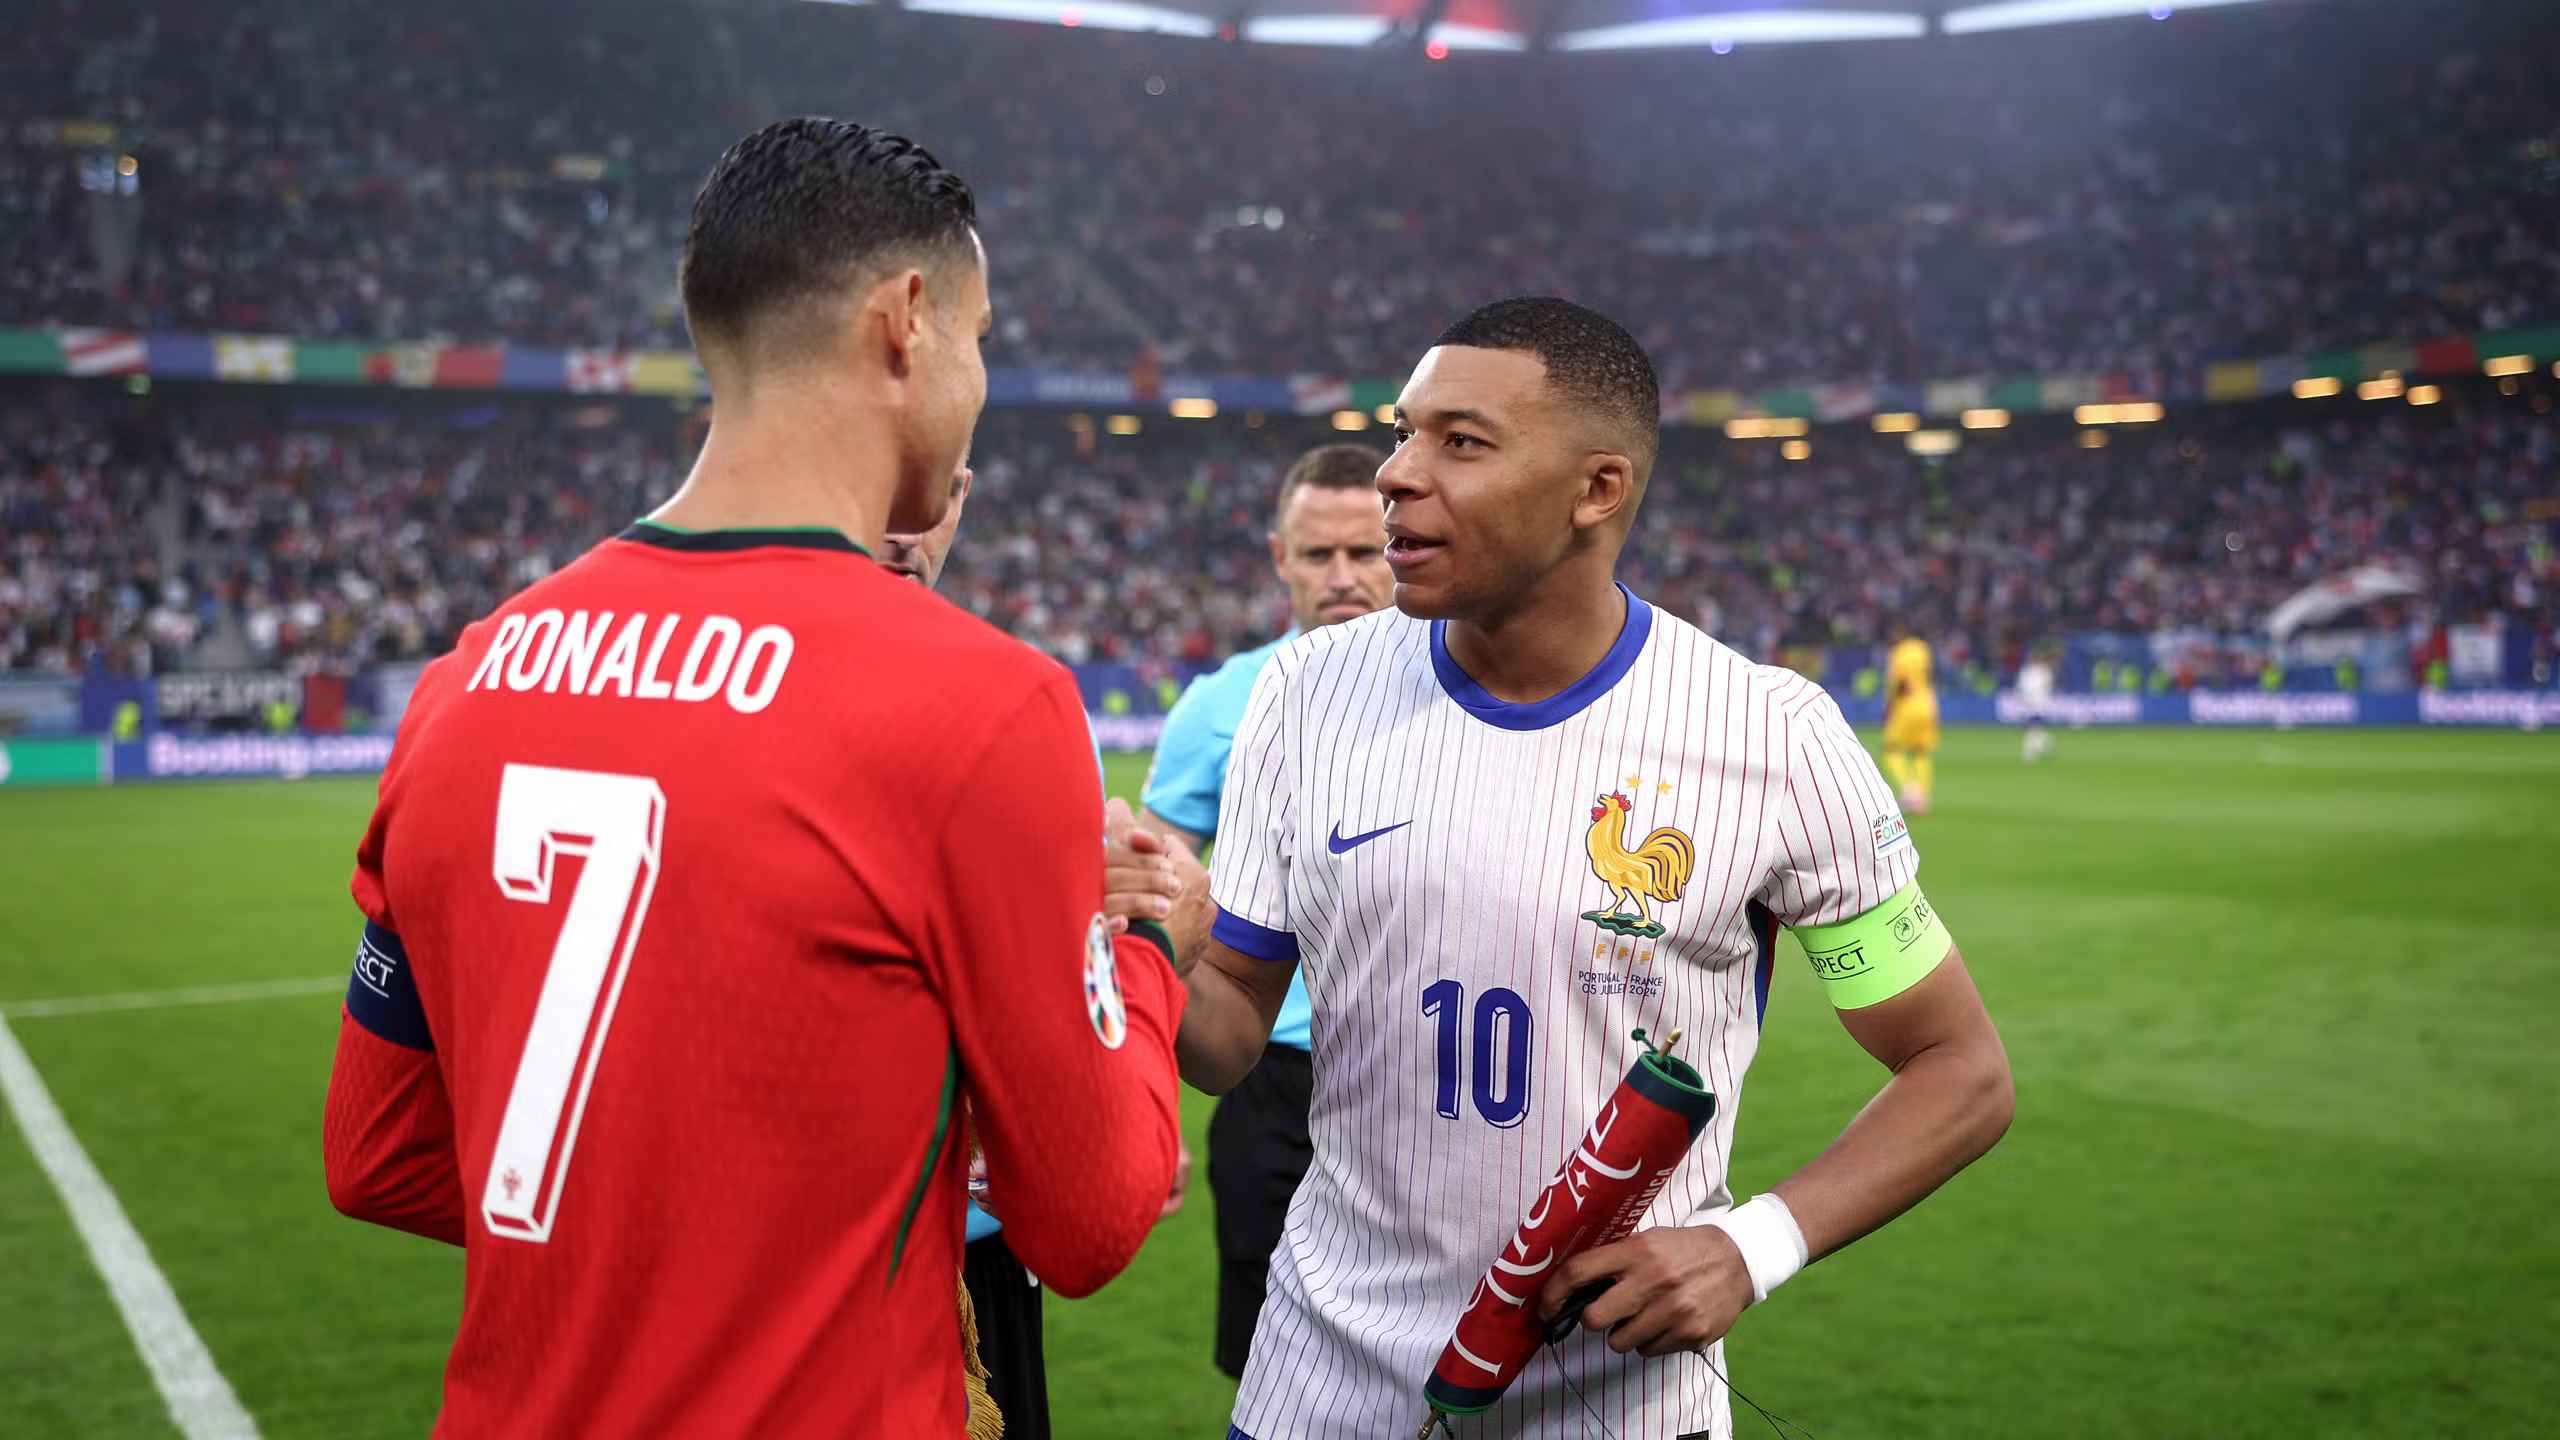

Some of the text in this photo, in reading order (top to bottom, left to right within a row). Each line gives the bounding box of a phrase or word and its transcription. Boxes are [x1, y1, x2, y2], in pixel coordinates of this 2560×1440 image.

[466, 608, 795, 714] RONALDO
[356, 940, 394, 987] ECT
[1579, 970, 1620, 984] PORTUGAL
[1630, 974, 1663, 988] FRANCE
[1810, 946, 1865, 974] SPECT
[482, 763, 666, 1243] 7
[1582, 983, 1657, 998] 05 JUILLET 2024
[1422, 979, 1534, 1129] 10
